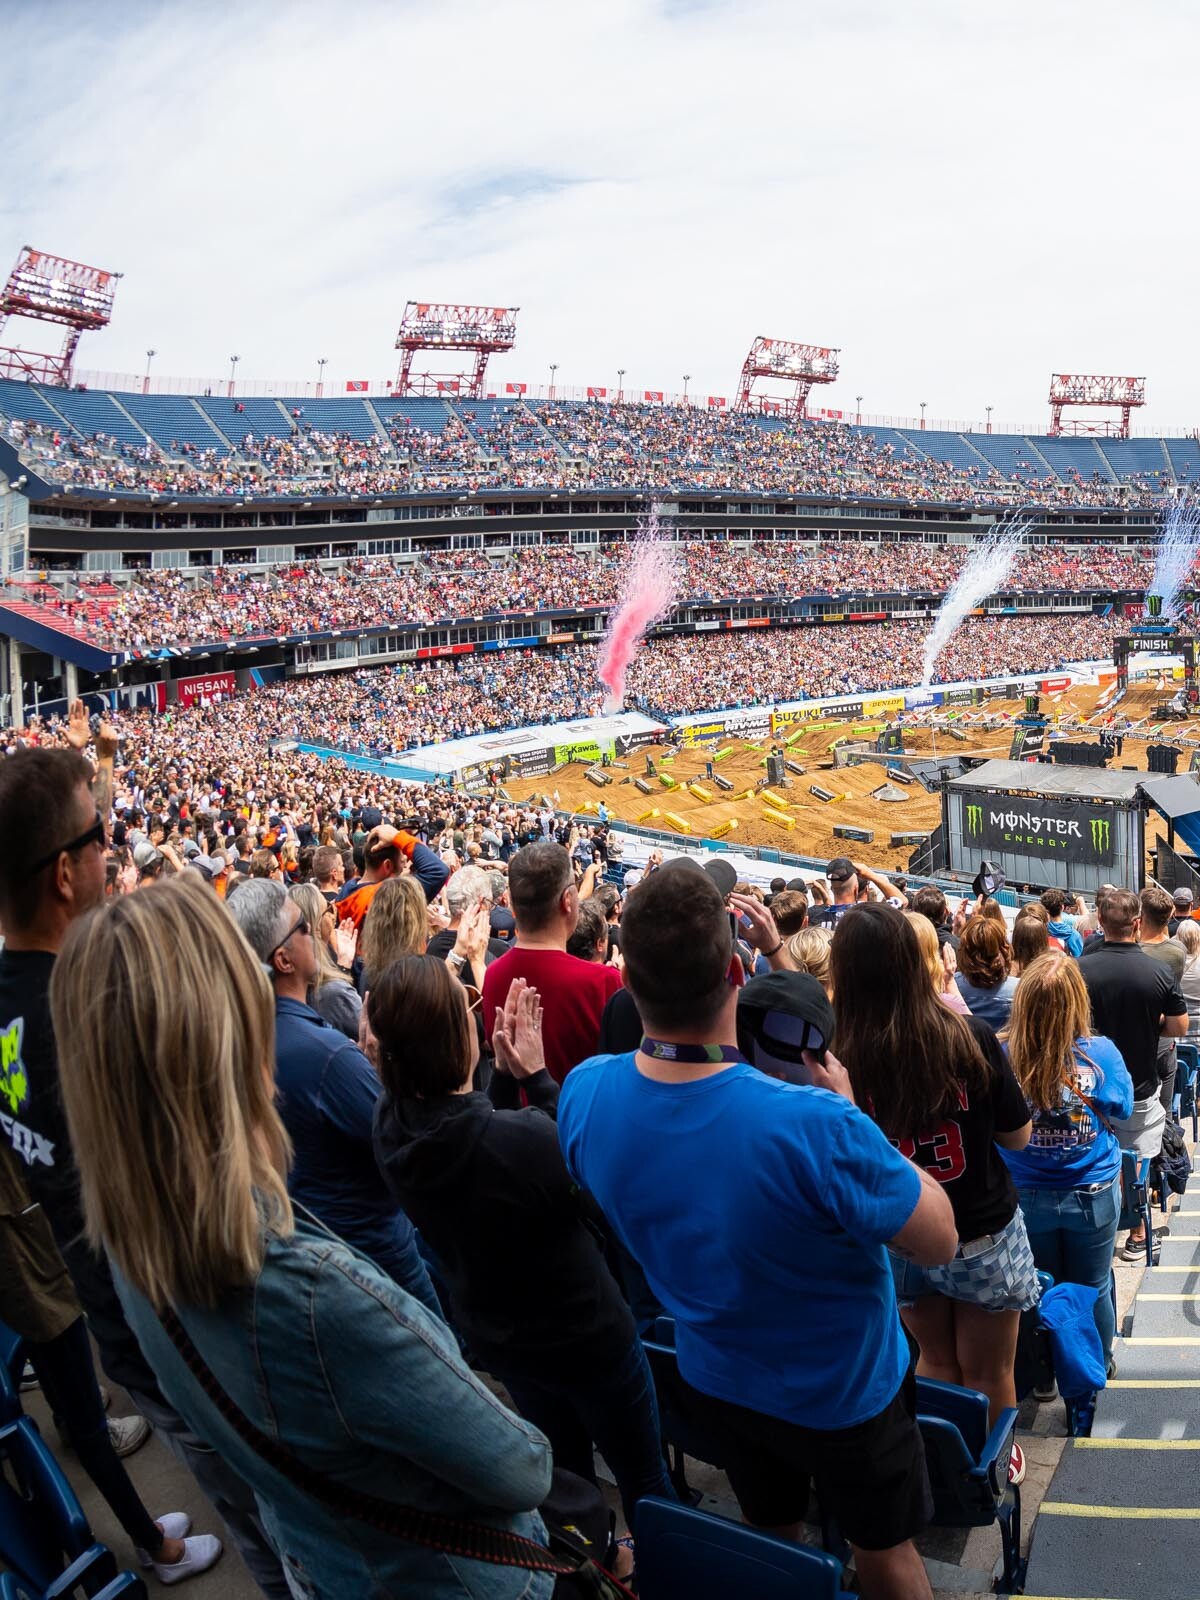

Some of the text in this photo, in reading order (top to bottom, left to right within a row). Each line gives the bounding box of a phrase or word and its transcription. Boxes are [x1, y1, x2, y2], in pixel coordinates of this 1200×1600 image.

[1133, 639, 1169, 650] FINISH
[184, 678, 228, 696] NISSAN
[832, 703, 863, 714] OAKLEY
[872, 699, 902, 708] DUNLOP
[775, 708, 818, 723] SUZUKI
[571, 743, 599, 754] Kawas
[519, 754, 548, 763] COMMISSION
[990, 811, 1083, 839] MONSTER
[1004, 833, 1068, 848] ENERGY
